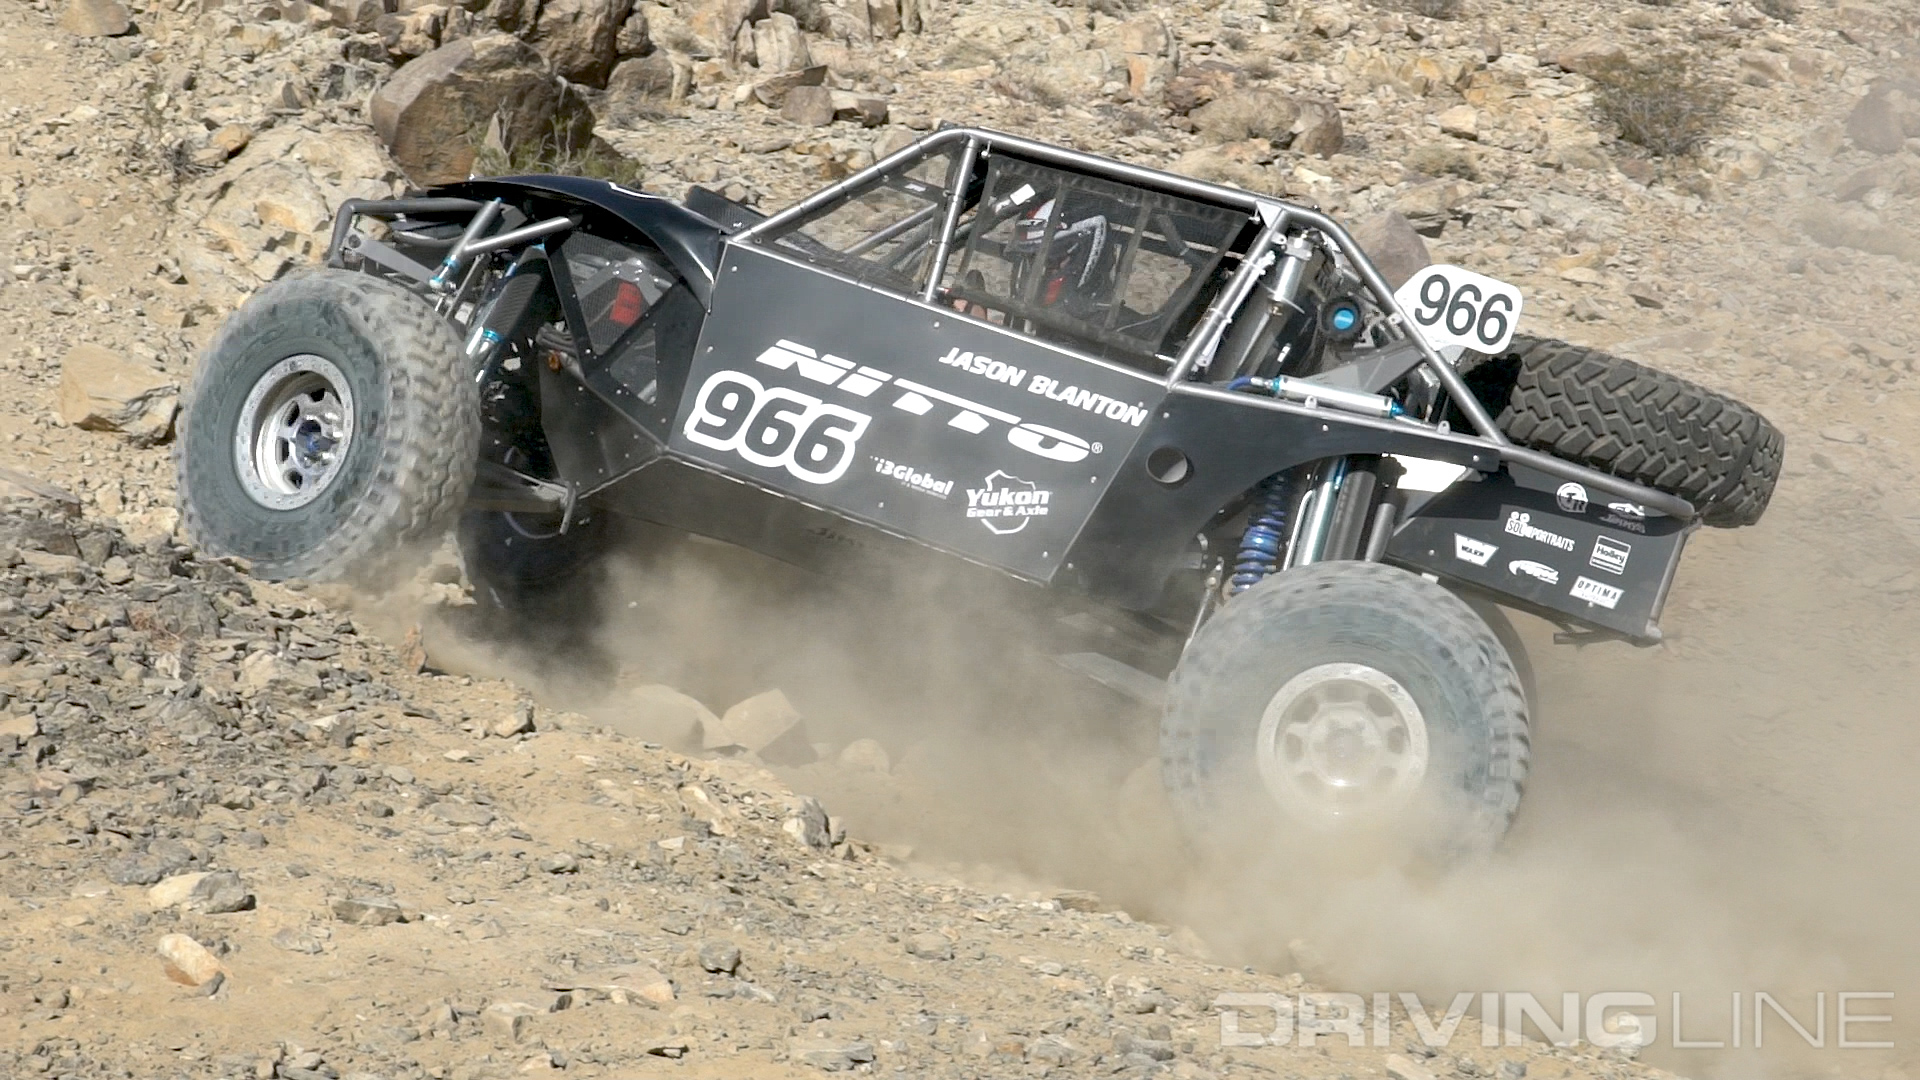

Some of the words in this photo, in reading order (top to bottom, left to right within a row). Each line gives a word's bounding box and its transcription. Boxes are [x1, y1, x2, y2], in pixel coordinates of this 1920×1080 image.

[1414, 273, 1513, 346] 966
[755, 338, 1091, 463] NITTO
[938, 347, 1027, 387] JASON
[1027, 375, 1149, 427] BLANTON
[687, 373, 867, 481] 966
[875, 457, 954, 496] i3Global
[965, 488, 1050, 507] Yukon
[966, 507, 1002, 518] Gear
[1002, 506, 1014, 517] &
[1014, 505, 1049, 516] Axle
[1596, 545, 1626, 564] Holley
[1577, 580, 1618, 600] OPTIMA
